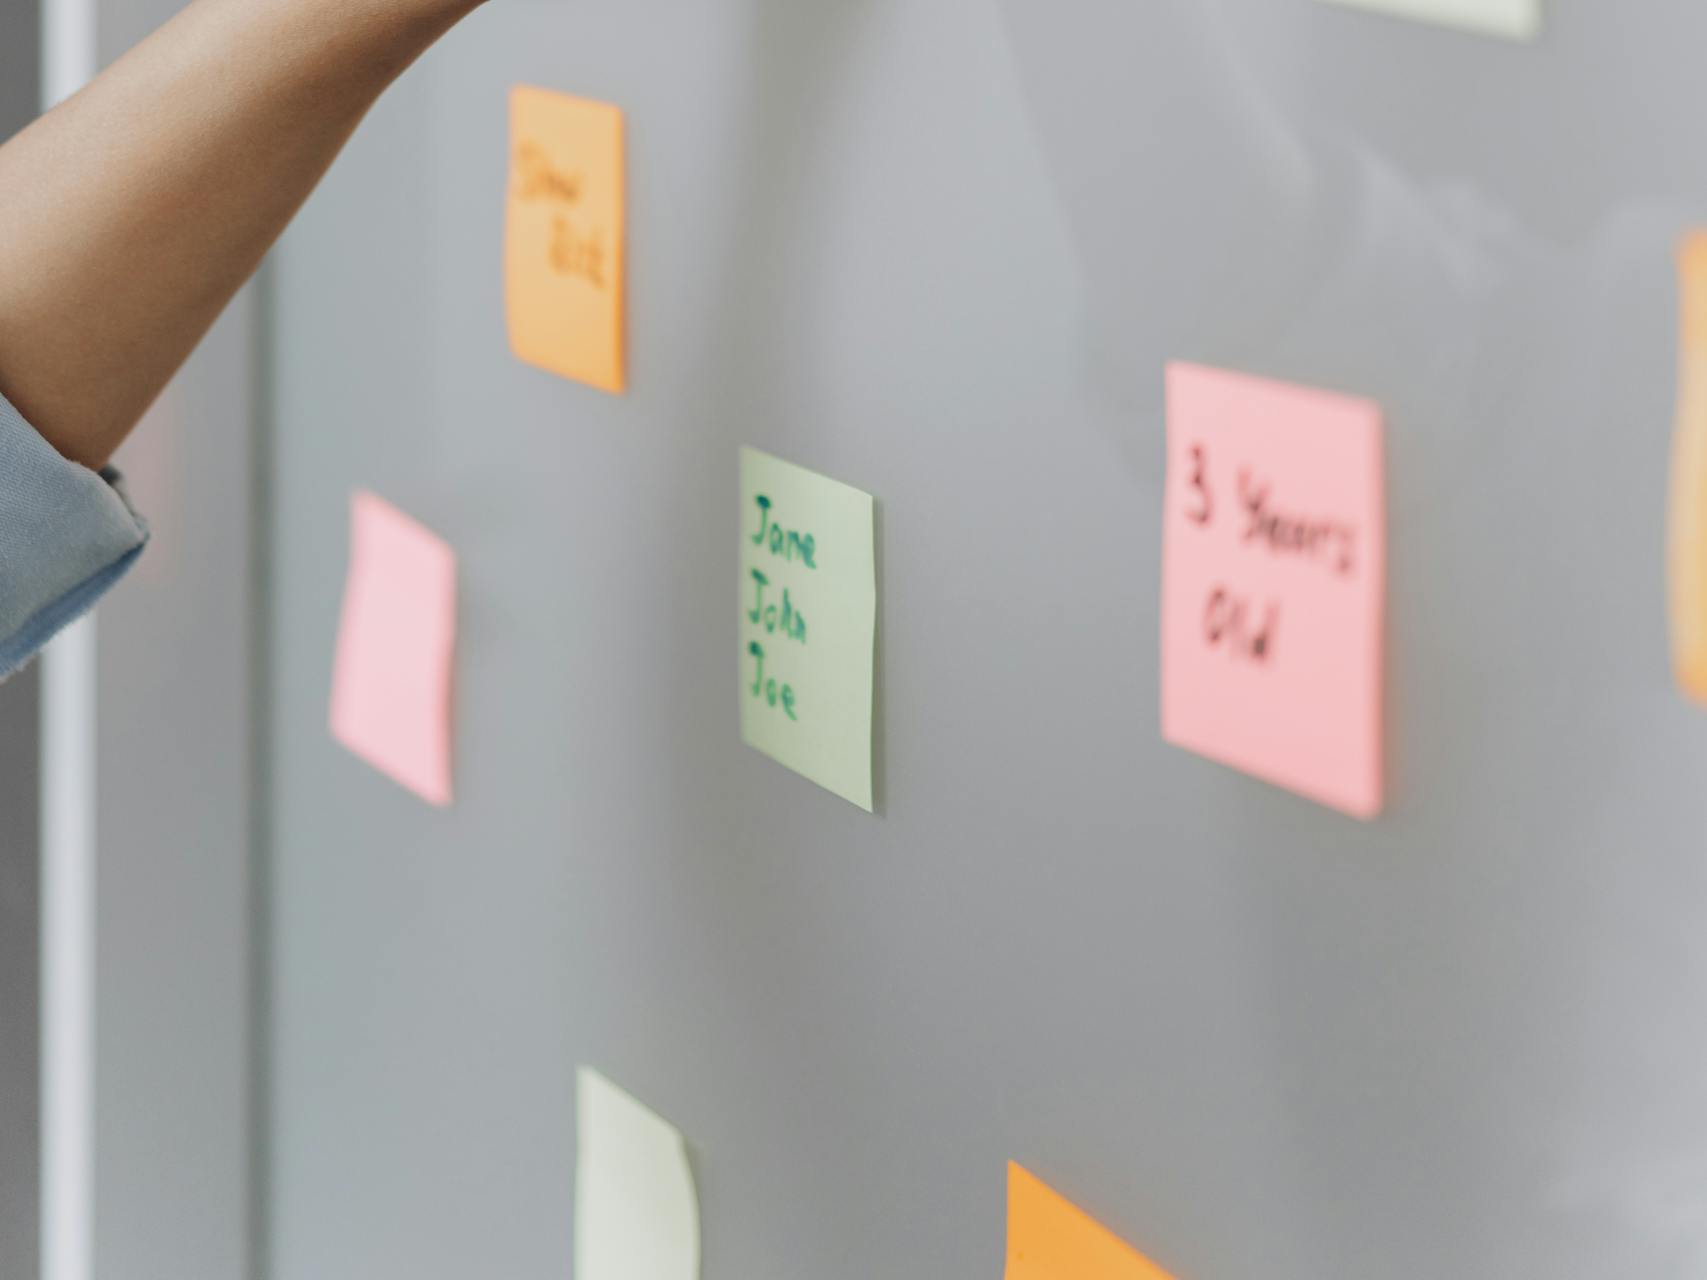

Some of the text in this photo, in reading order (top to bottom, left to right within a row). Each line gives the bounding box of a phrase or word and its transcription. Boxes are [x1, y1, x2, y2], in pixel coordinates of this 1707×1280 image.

[751, 495, 817, 570] Jane
[1183, 444, 1357, 576] 3 Years
[748, 569, 807, 644] John
[1203, 586, 1281, 661] Old
[748, 641, 798, 722] Joe
